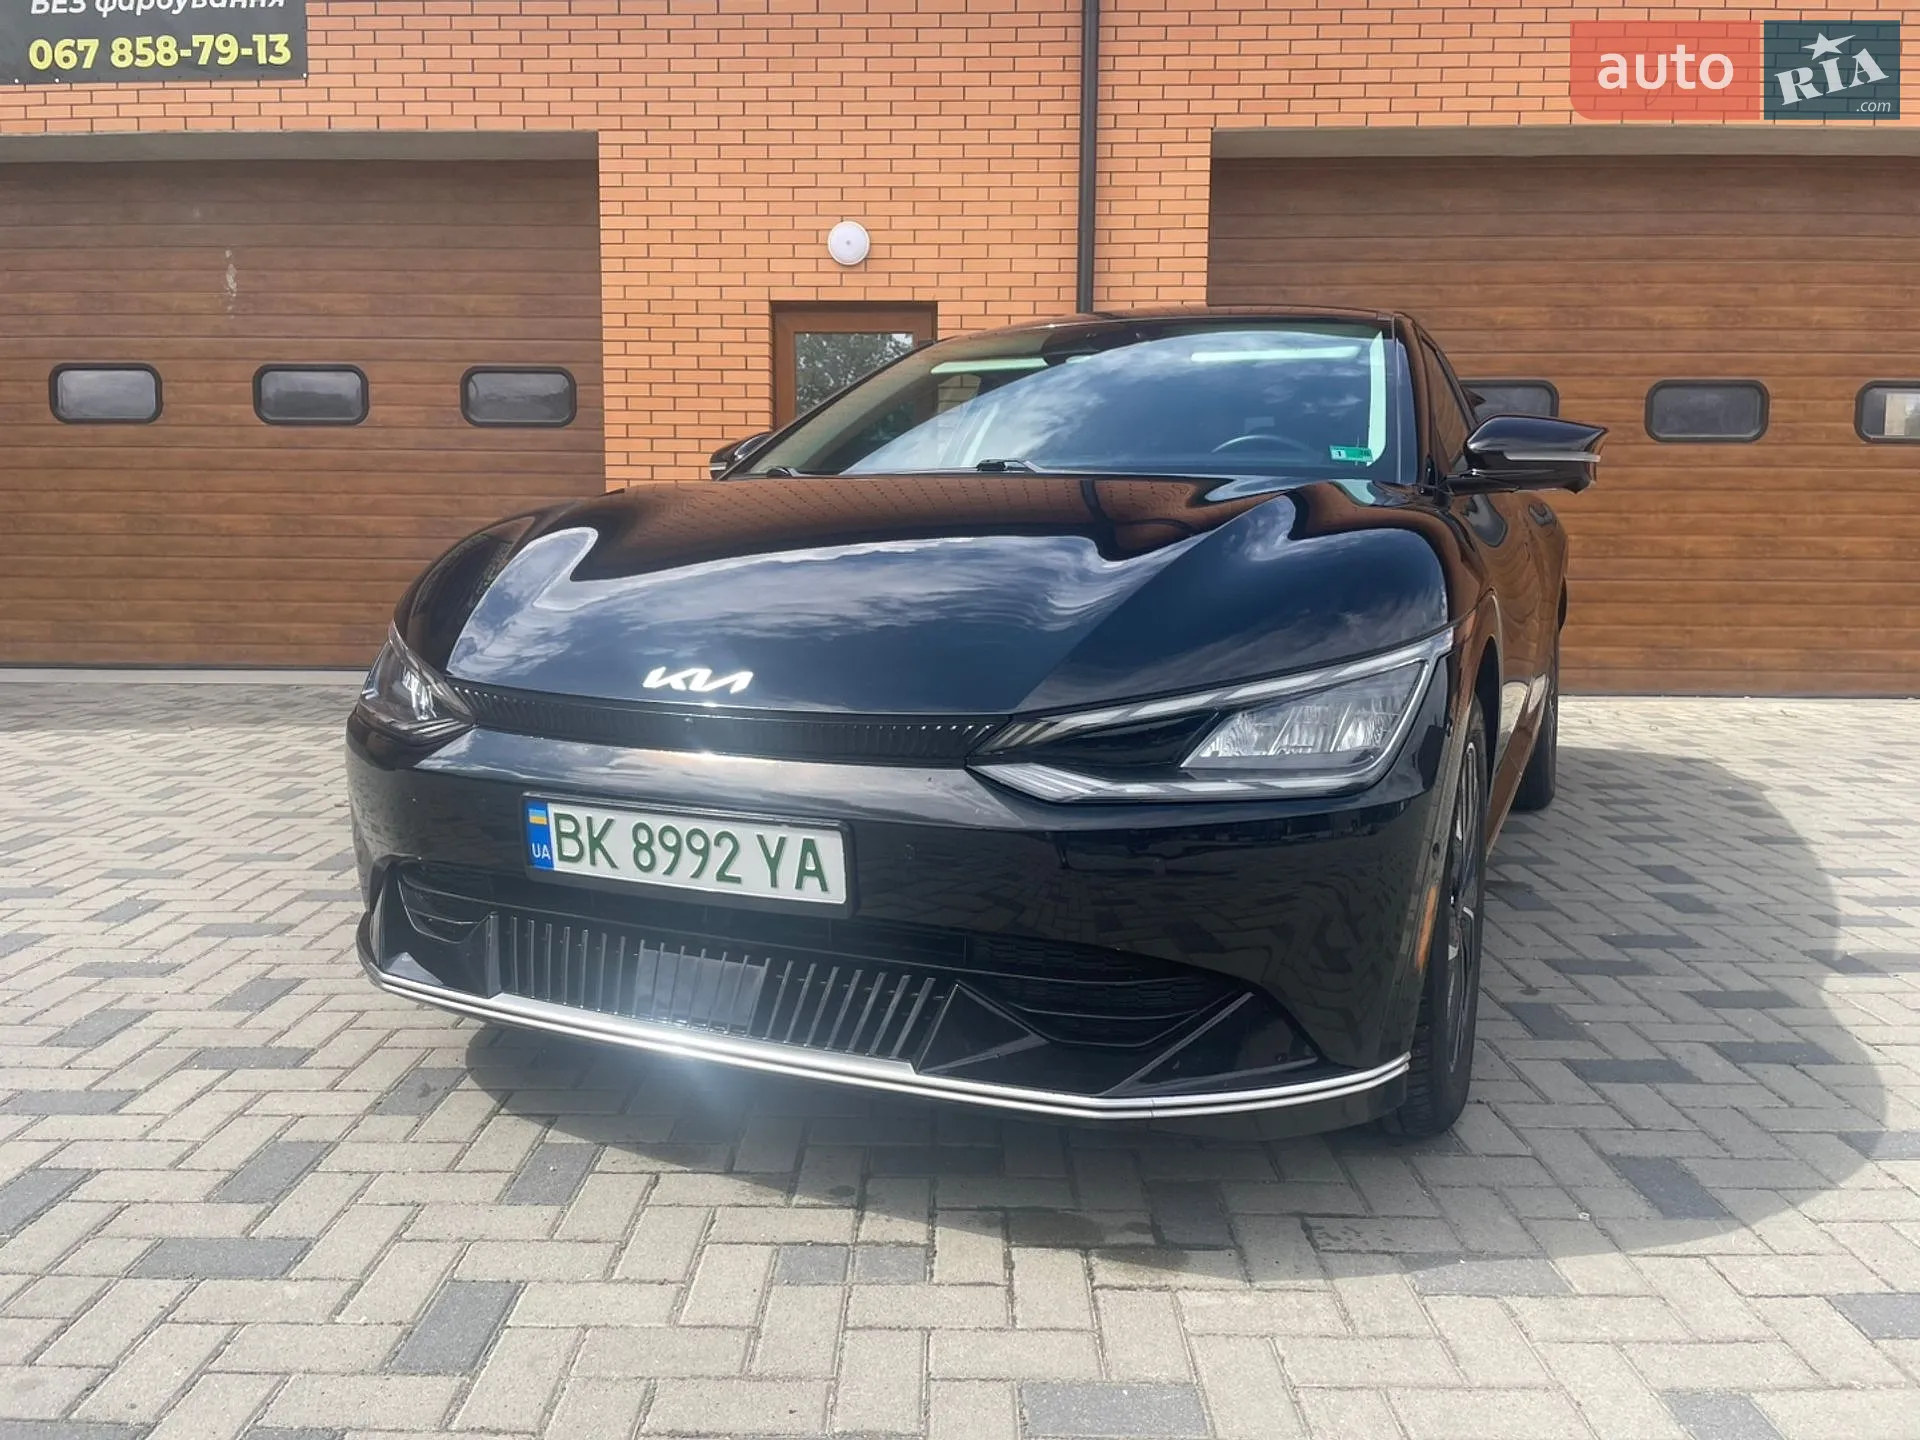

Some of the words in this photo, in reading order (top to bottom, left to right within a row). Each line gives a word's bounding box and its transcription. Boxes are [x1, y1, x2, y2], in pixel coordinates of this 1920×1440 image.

[28, 38, 99, 70] 067
[110, 33, 292, 68] 858-79-13
[531, 842, 552, 860] UA
[553, 812, 619, 870] BK
[631, 822, 742, 884] 8992
[756, 833, 829, 893] YA
